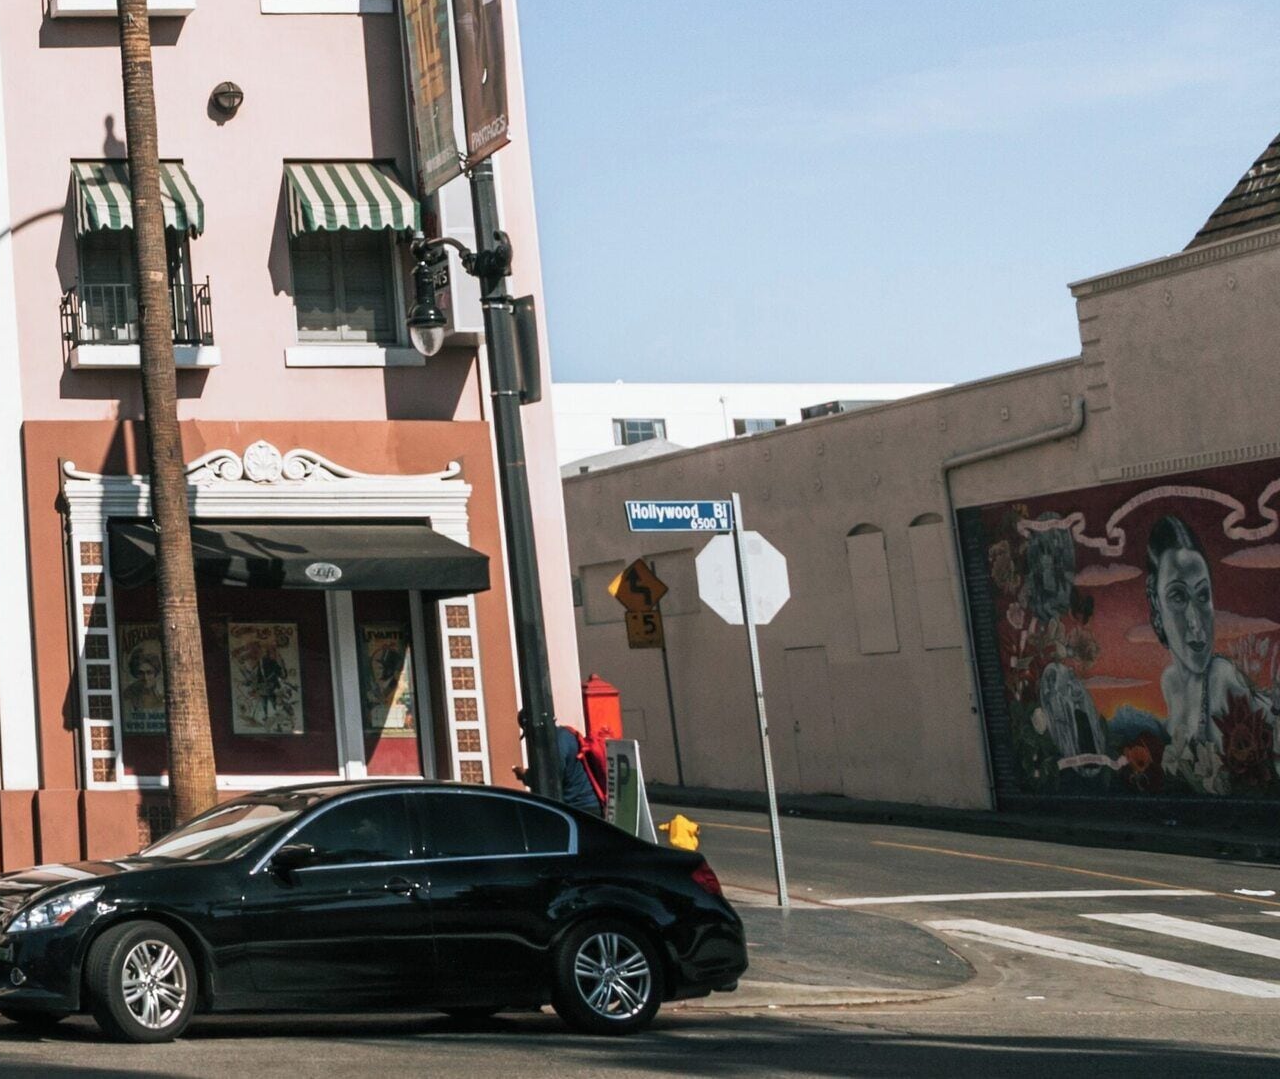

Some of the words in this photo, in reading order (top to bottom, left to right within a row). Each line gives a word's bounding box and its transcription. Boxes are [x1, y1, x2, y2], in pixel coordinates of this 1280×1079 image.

[471, 114, 506, 153] PANTAGES
[630, 504, 699, 523] Hollywood
[691, 518, 716, 529] 6500
[719, 518, 729, 528] W
